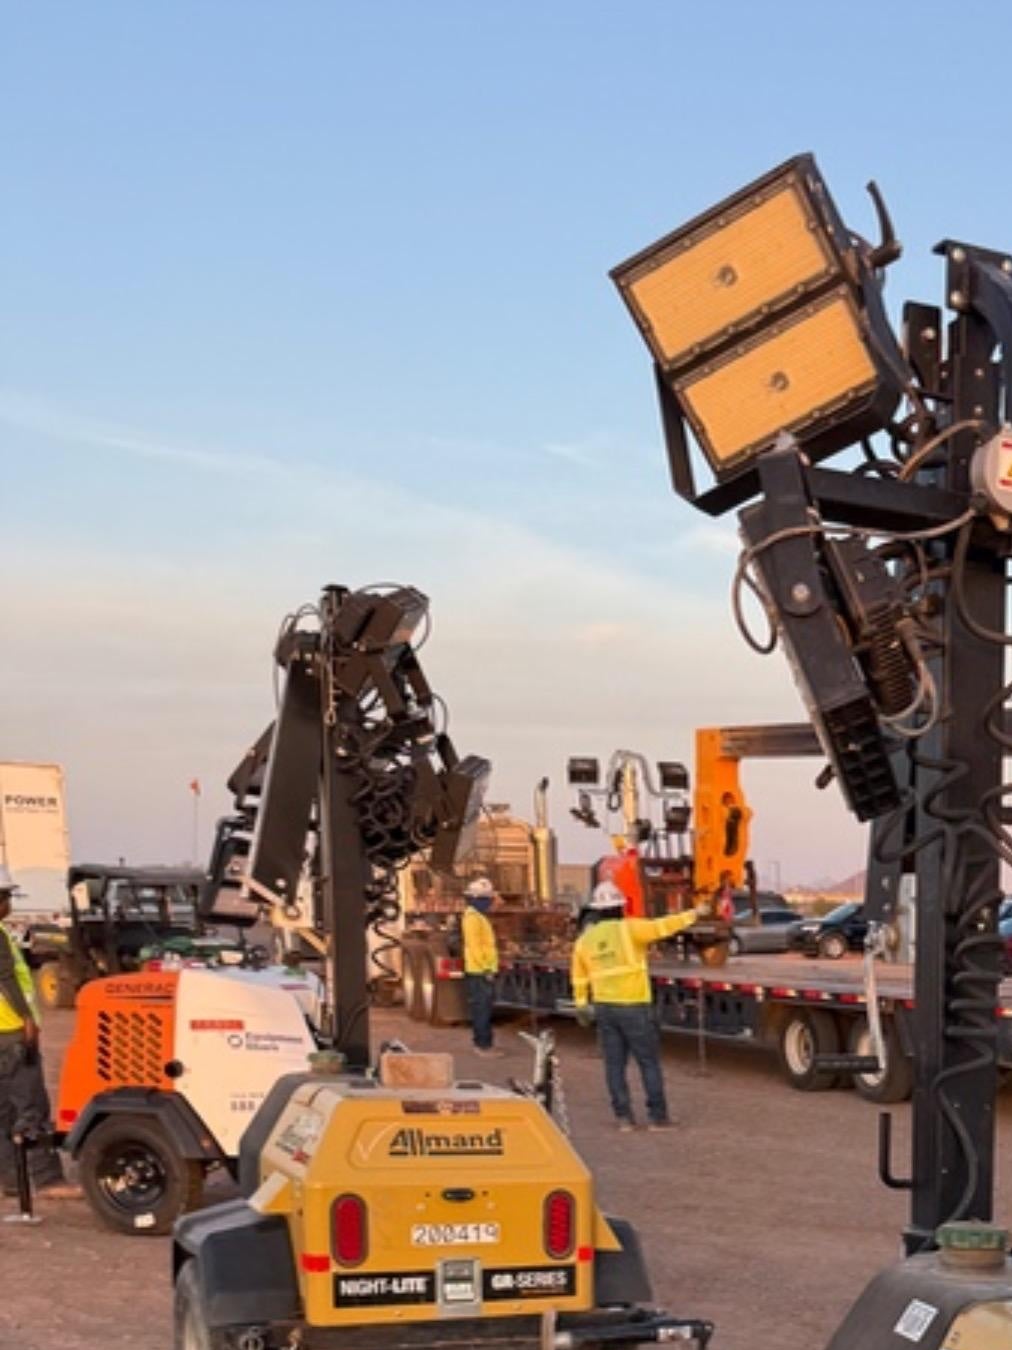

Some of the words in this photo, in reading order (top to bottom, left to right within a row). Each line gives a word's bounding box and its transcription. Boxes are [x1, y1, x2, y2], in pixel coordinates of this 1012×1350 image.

[4, 794, 58, 807] POWER
[104, 982, 177, 995] GENERAC
[389, 1127, 504, 1156] Allmand
[339, 1276, 429, 1297] NIGHT-LITE
[490, 1271, 568, 1290] GR-SERIES
